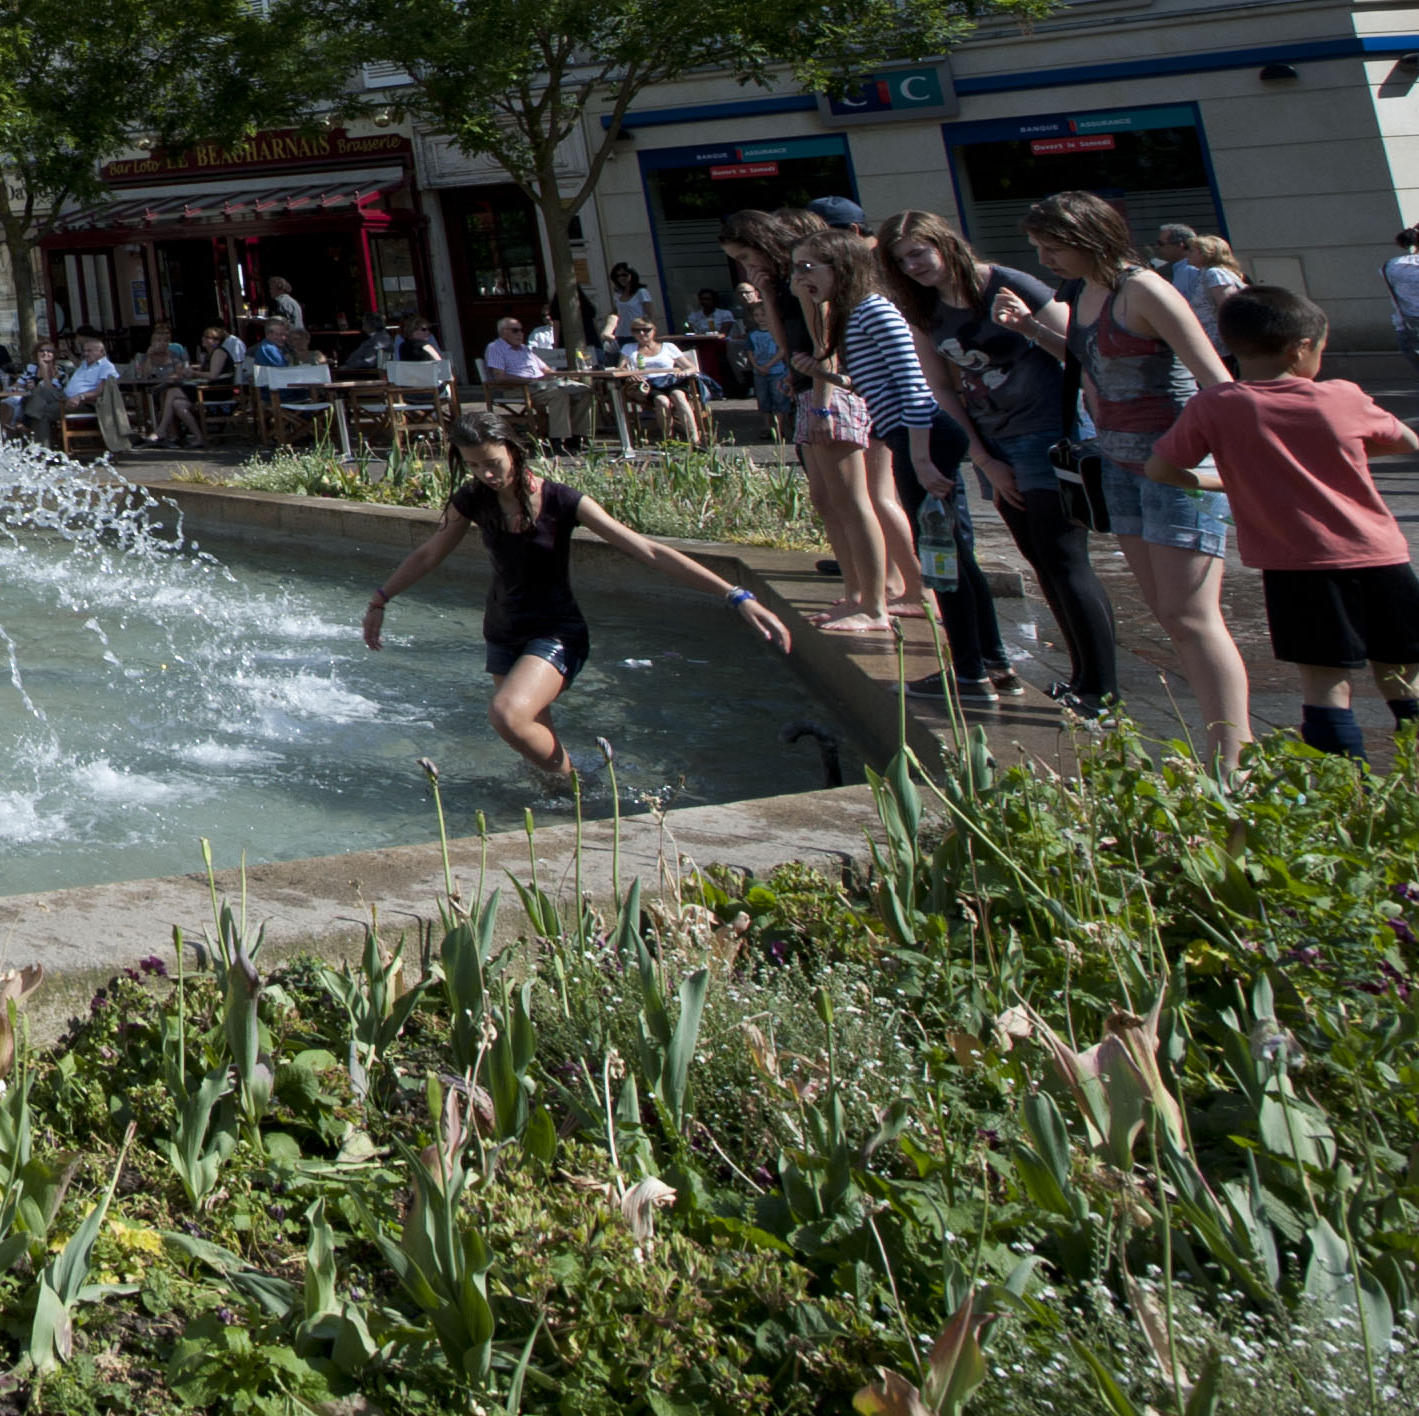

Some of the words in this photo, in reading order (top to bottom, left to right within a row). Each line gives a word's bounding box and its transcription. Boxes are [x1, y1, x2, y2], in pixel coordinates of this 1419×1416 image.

[1020, 124, 1059, 133] BANQUE
[1080, 117, 1132, 128] ASSURANCE
[109, 161, 130, 176] Bar
[134, 159, 159, 173] Loto
[196, 135, 330, 168] BEAUHARNAIS
[337, 135, 401, 154] Brasserie
